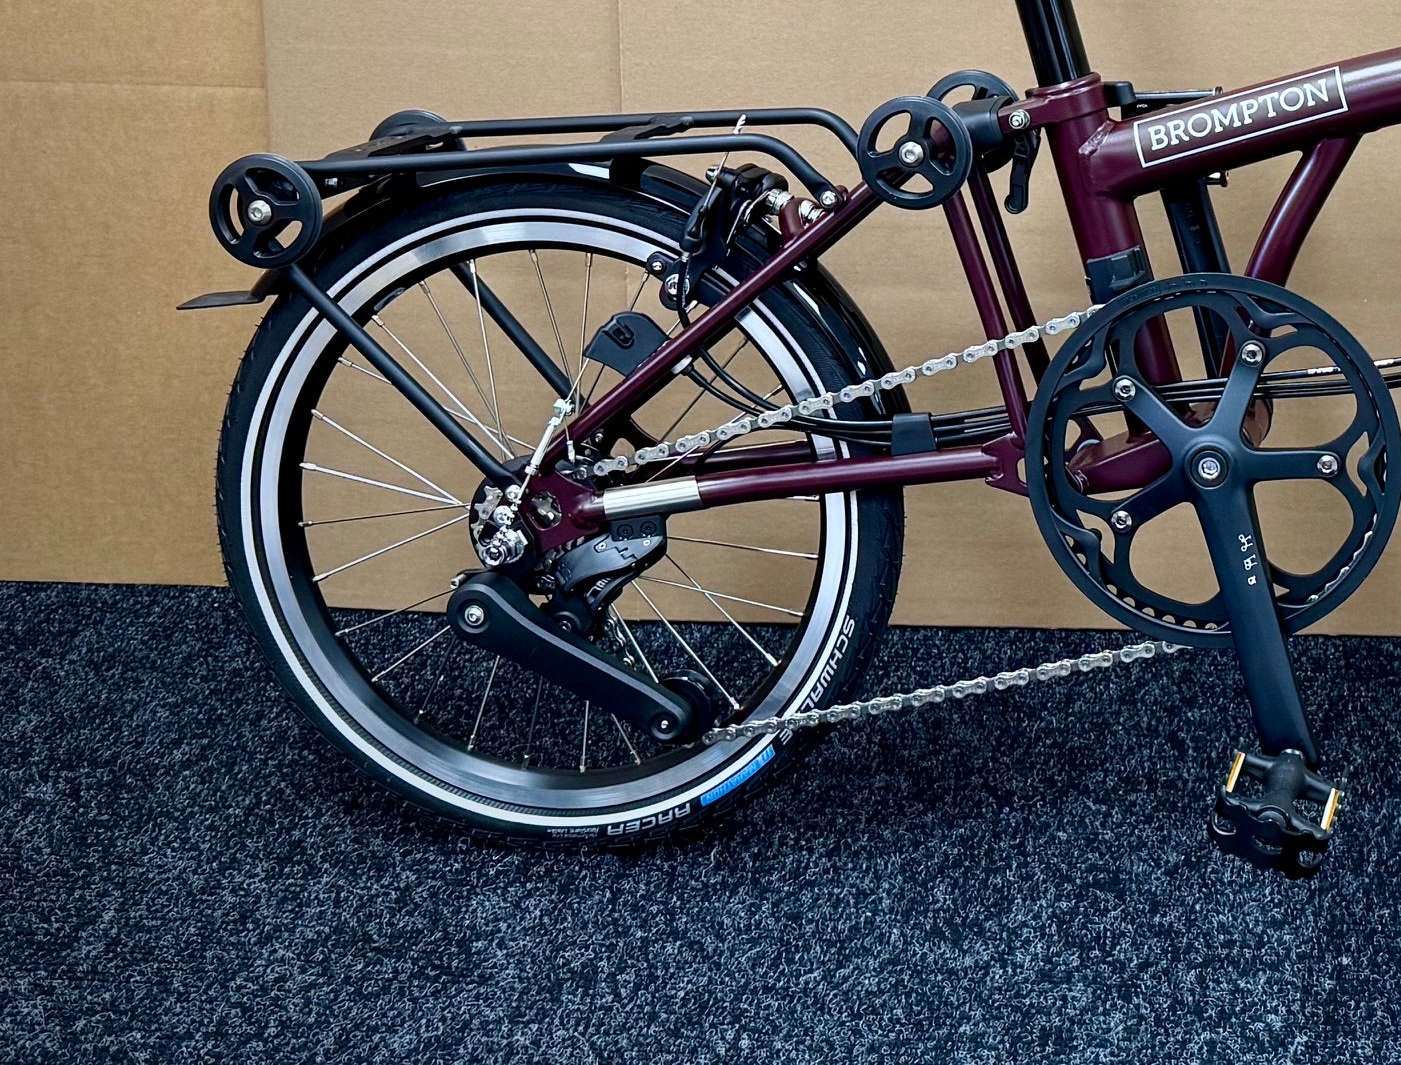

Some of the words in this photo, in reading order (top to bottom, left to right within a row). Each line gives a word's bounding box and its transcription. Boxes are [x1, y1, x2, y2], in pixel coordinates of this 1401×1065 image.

[1148, 78, 1330, 151] BROMPTON
[779, 614, 856, 746] SCHWALE
[606, 803, 691, 835] RACER
